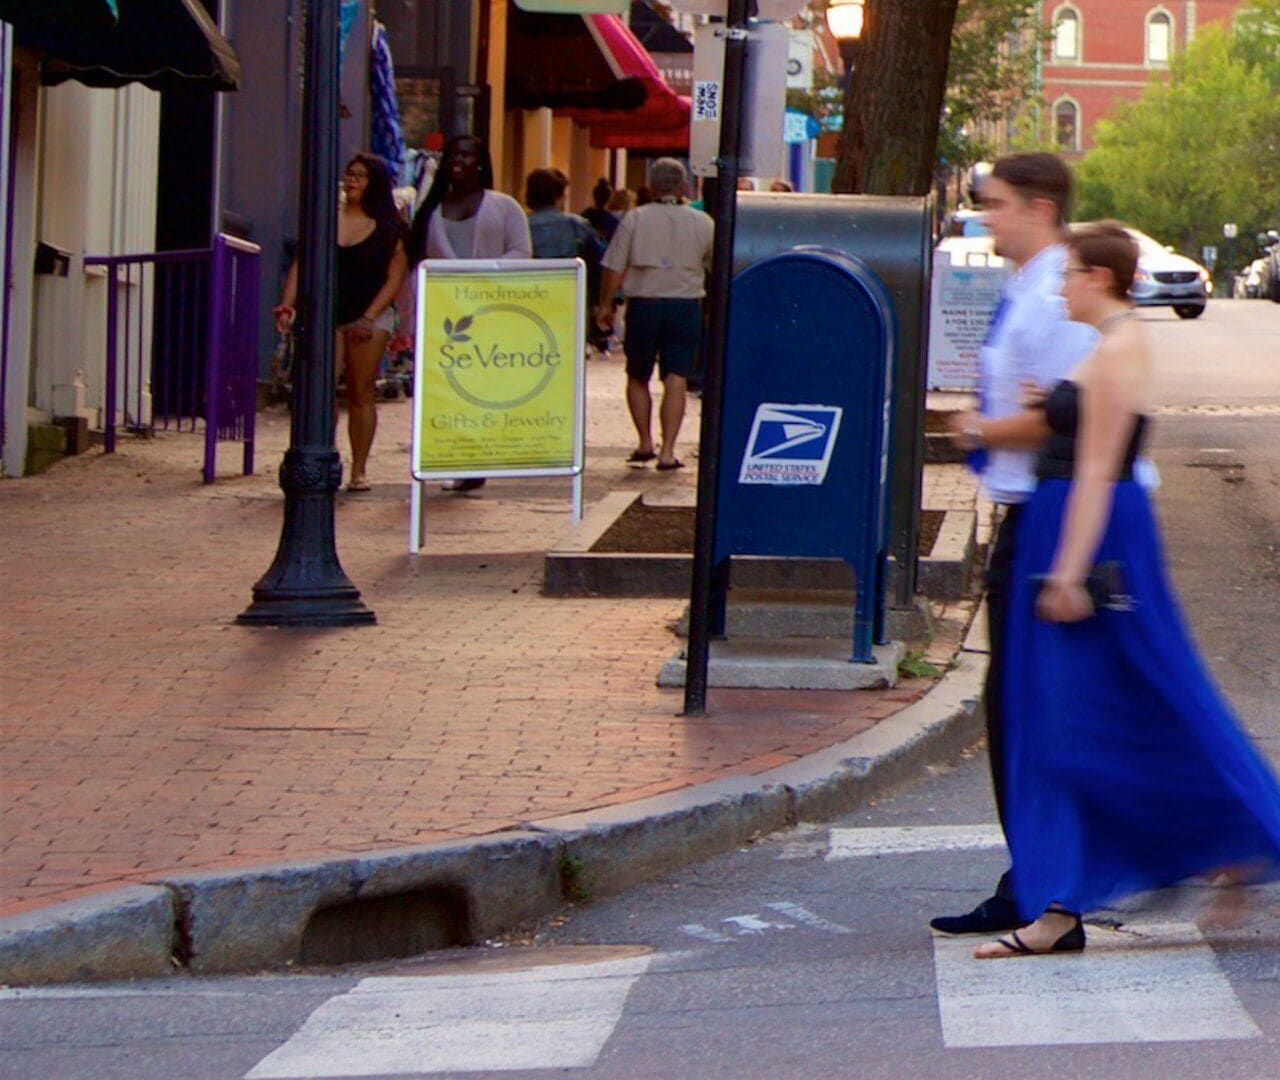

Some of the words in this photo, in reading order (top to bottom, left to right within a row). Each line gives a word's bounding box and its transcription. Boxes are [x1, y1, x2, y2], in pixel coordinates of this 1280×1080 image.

[455, 286, 549, 300] Handmade
[431, 413, 479, 430] Gifts
[483, 412, 497, 429] &
[502, 411, 566, 432] Jewelry
[785, 464, 817, 472] STATES
[745, 473, 778, 481] POSTAL
[781, 473, 819, 481] SERVICE
